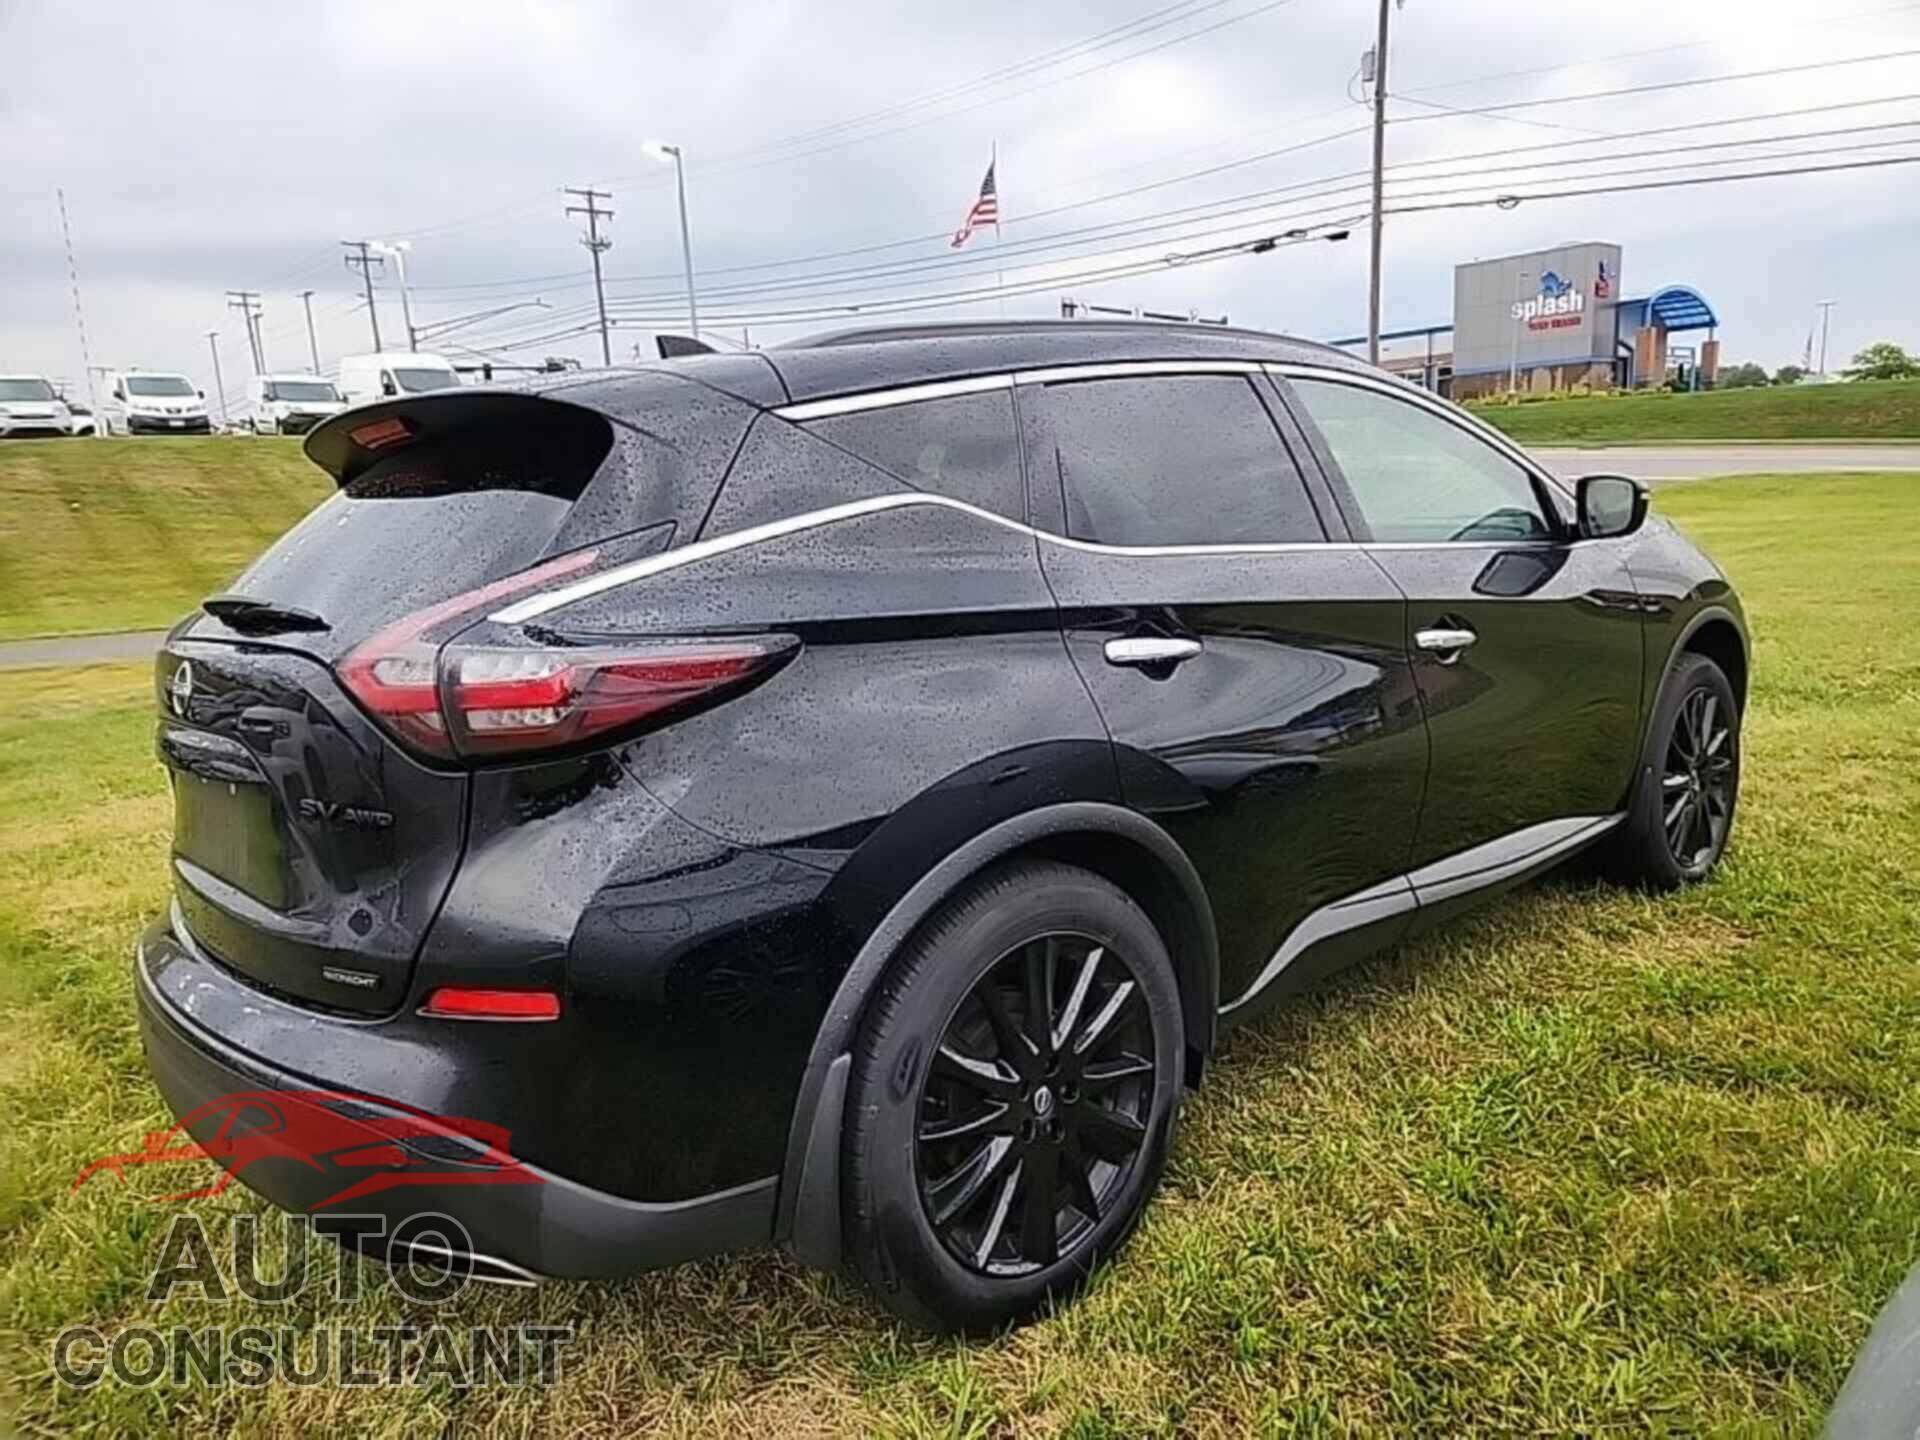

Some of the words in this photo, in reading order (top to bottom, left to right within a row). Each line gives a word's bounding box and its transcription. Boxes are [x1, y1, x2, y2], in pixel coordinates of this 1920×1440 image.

[1511, 288, 1583, 322] splash
[299, 798, 338, 818] SV
[344, 807, 394, 827] AWD
